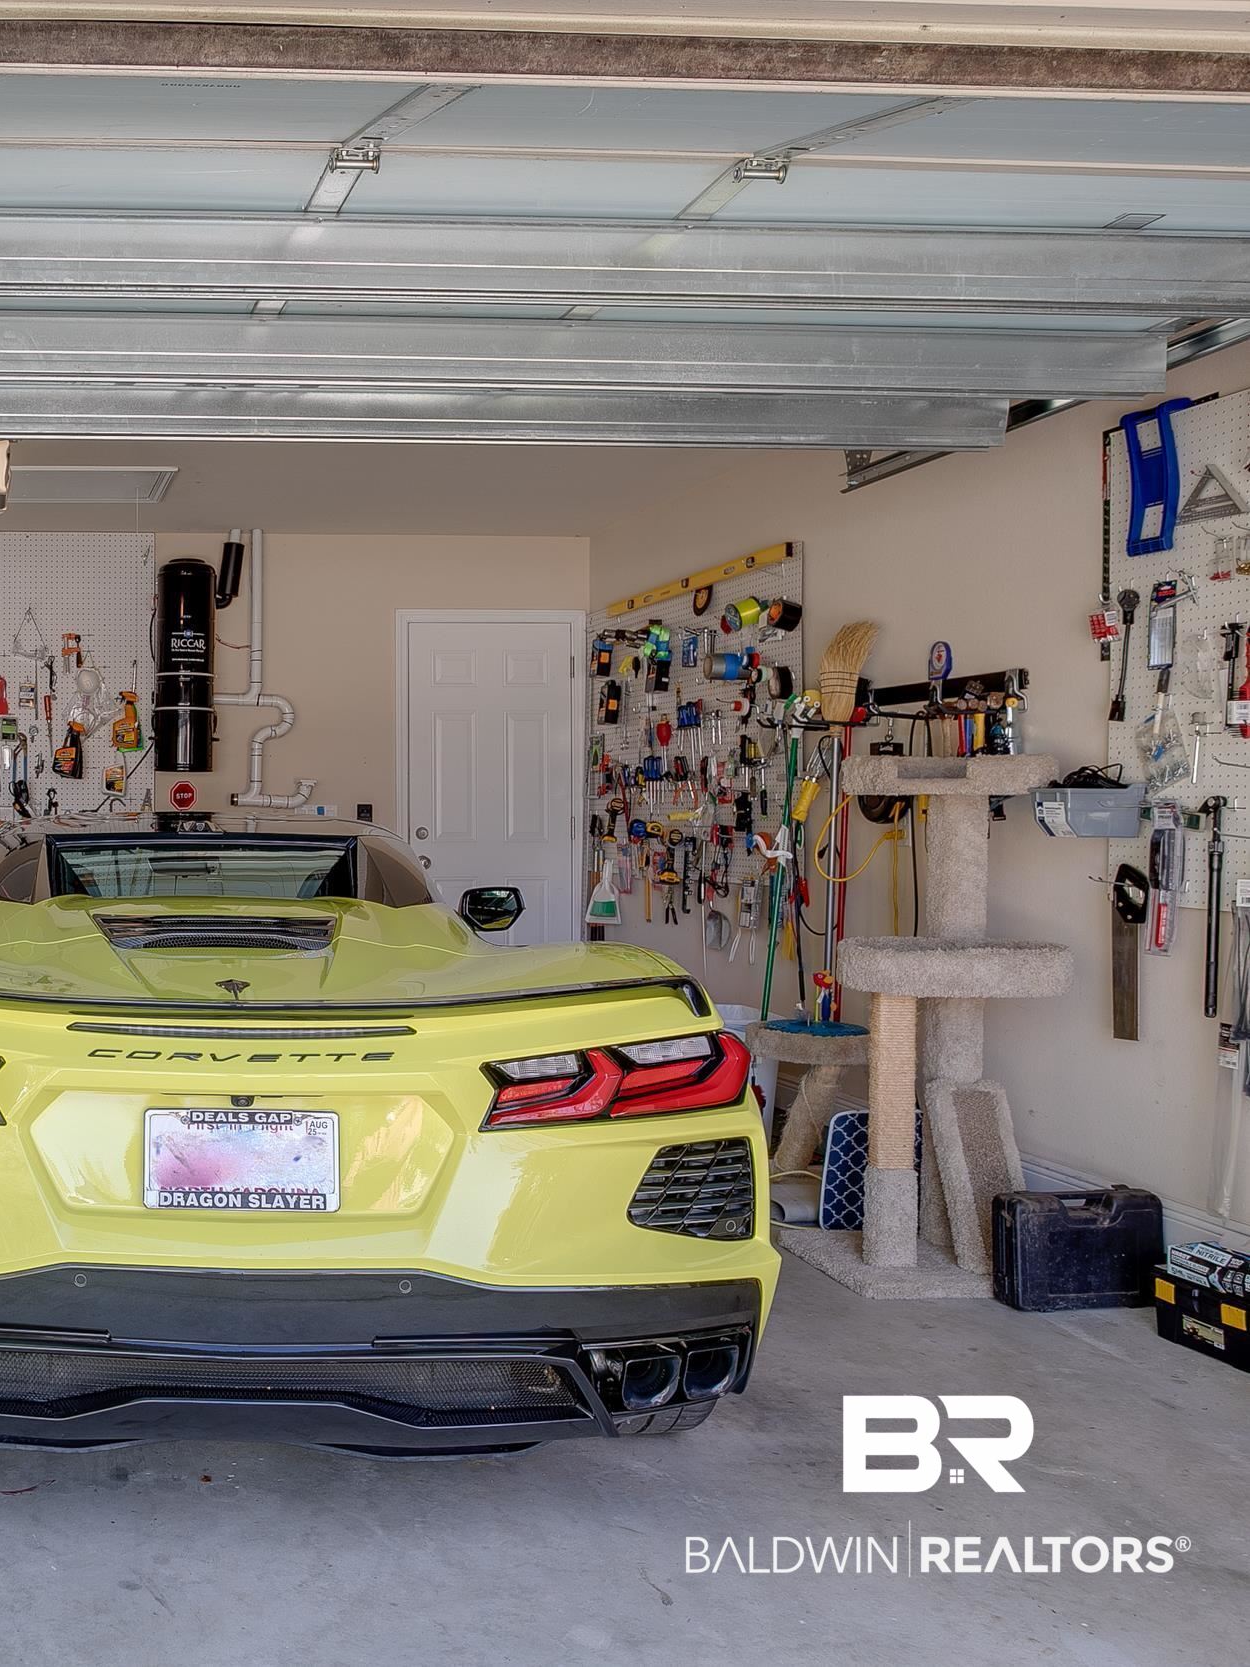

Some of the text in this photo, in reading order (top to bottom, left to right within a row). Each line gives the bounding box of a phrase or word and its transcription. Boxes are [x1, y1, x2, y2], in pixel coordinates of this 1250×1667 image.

[171, 638, 206, 649] RICCAR
[87, 1049, 396, 1063] CORVETTE
[192, 1112, 292, 1123] DEALS GAP
[309, 1121, 328, 1129] AUG
[159, 1192, 325, 1209] DRAGON SLAYER
[1195, 1248, 1226, 1265] NITRILE
